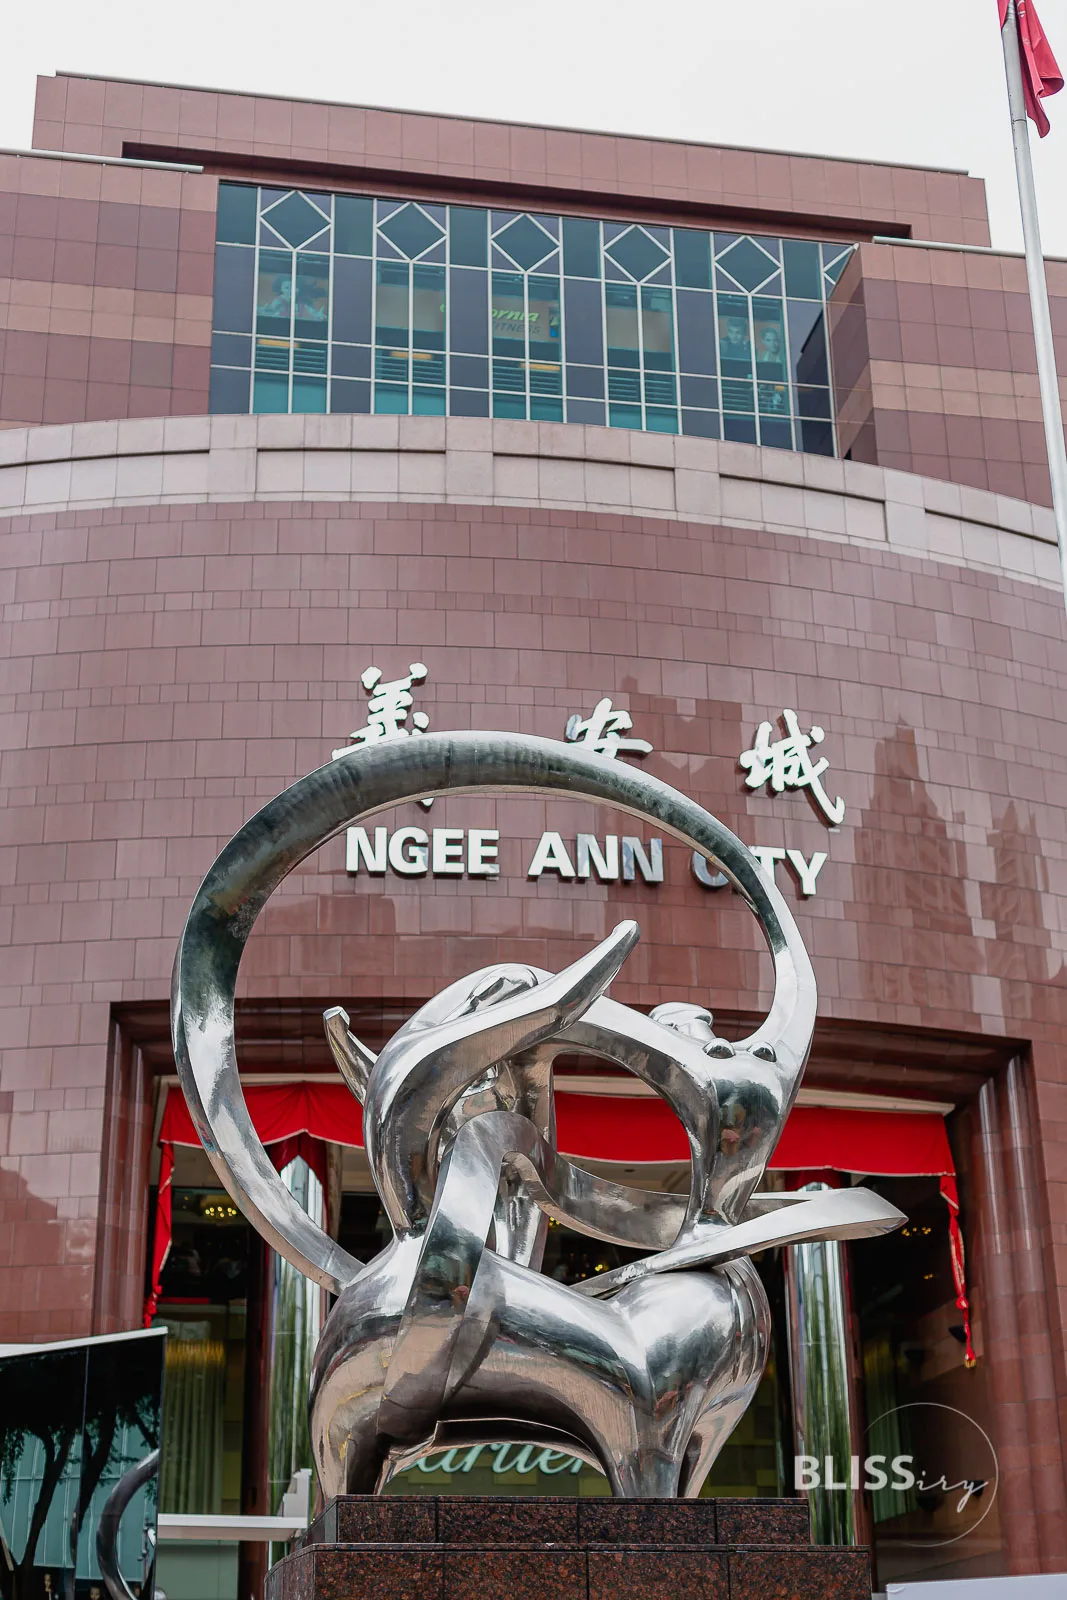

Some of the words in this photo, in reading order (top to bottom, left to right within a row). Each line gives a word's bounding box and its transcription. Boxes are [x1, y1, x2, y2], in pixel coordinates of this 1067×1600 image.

[346, 827, 500, 873] NGEE
[528, 832, 663, 882] ANN
[691, 846, 828, 895] CTY
[400, 1443, 584, 1474] artie
